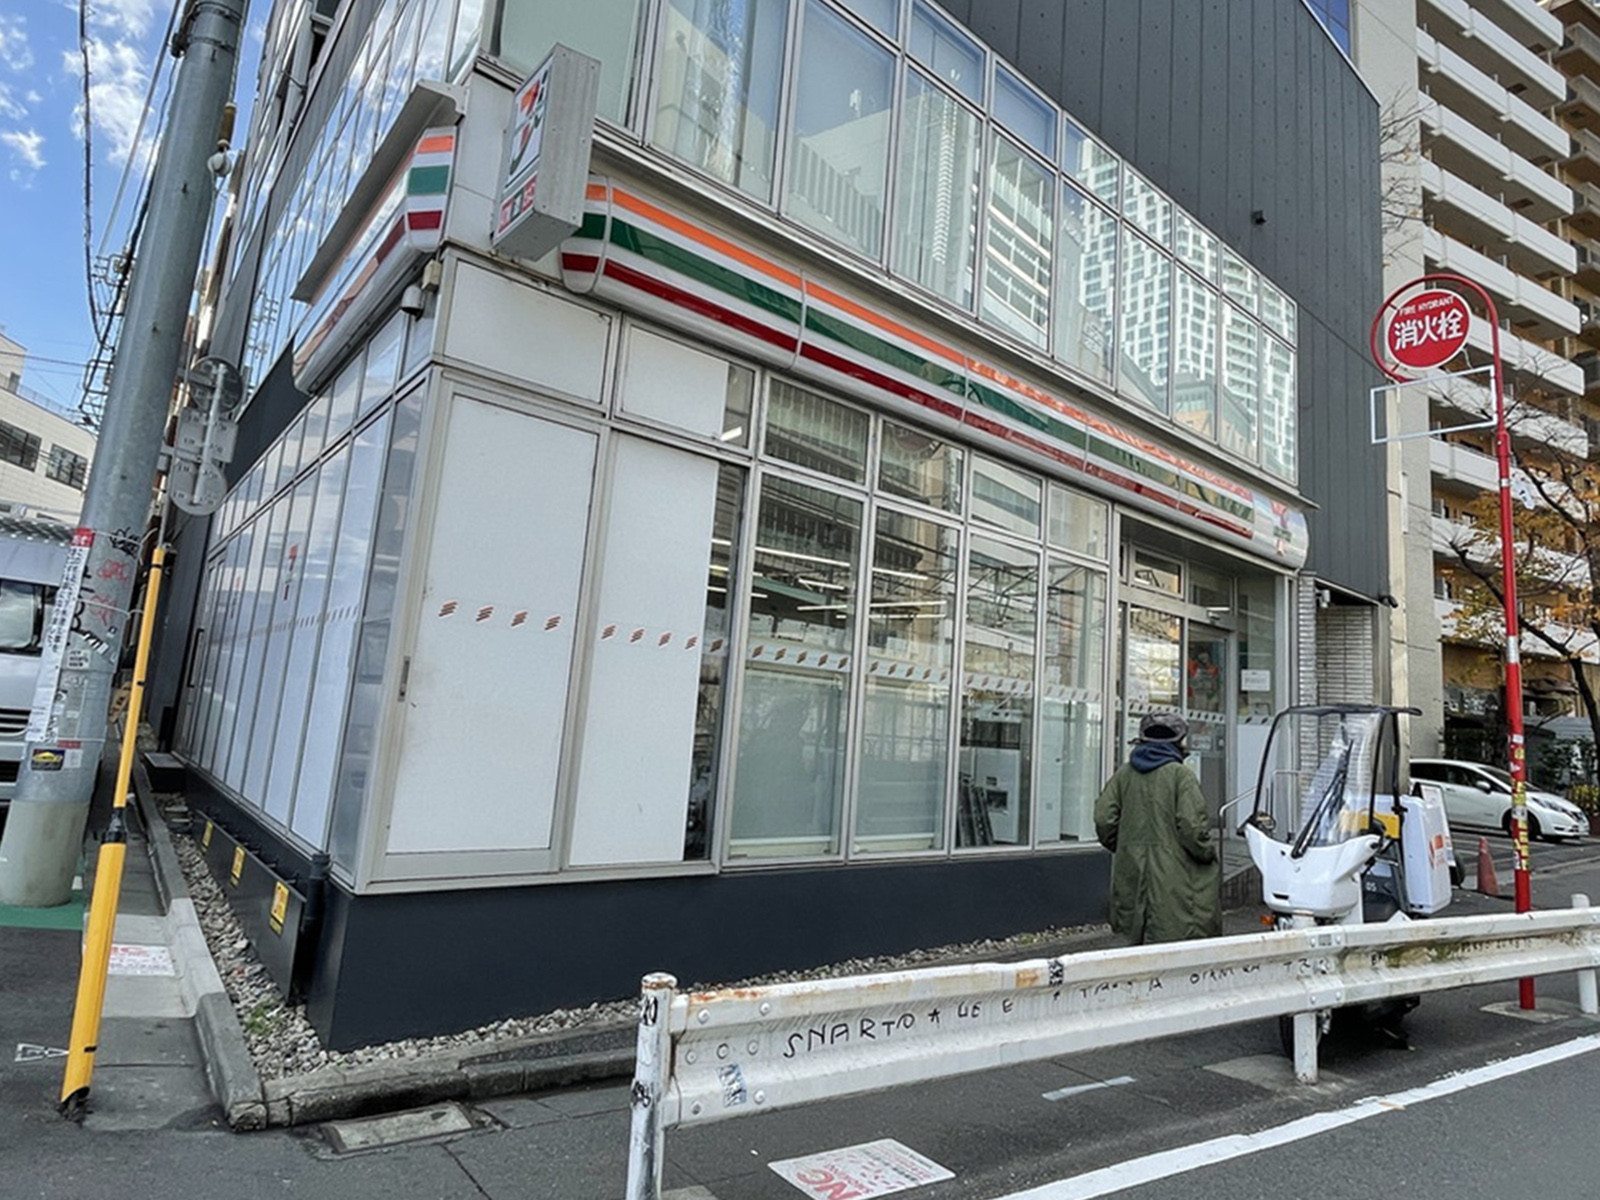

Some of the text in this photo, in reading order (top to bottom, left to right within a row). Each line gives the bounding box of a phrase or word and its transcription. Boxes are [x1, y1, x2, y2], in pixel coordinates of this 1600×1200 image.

[1399, 296, 1454, 317] FIRE HYDRANT
[1393, 307, 1464, 352] 消火栓
